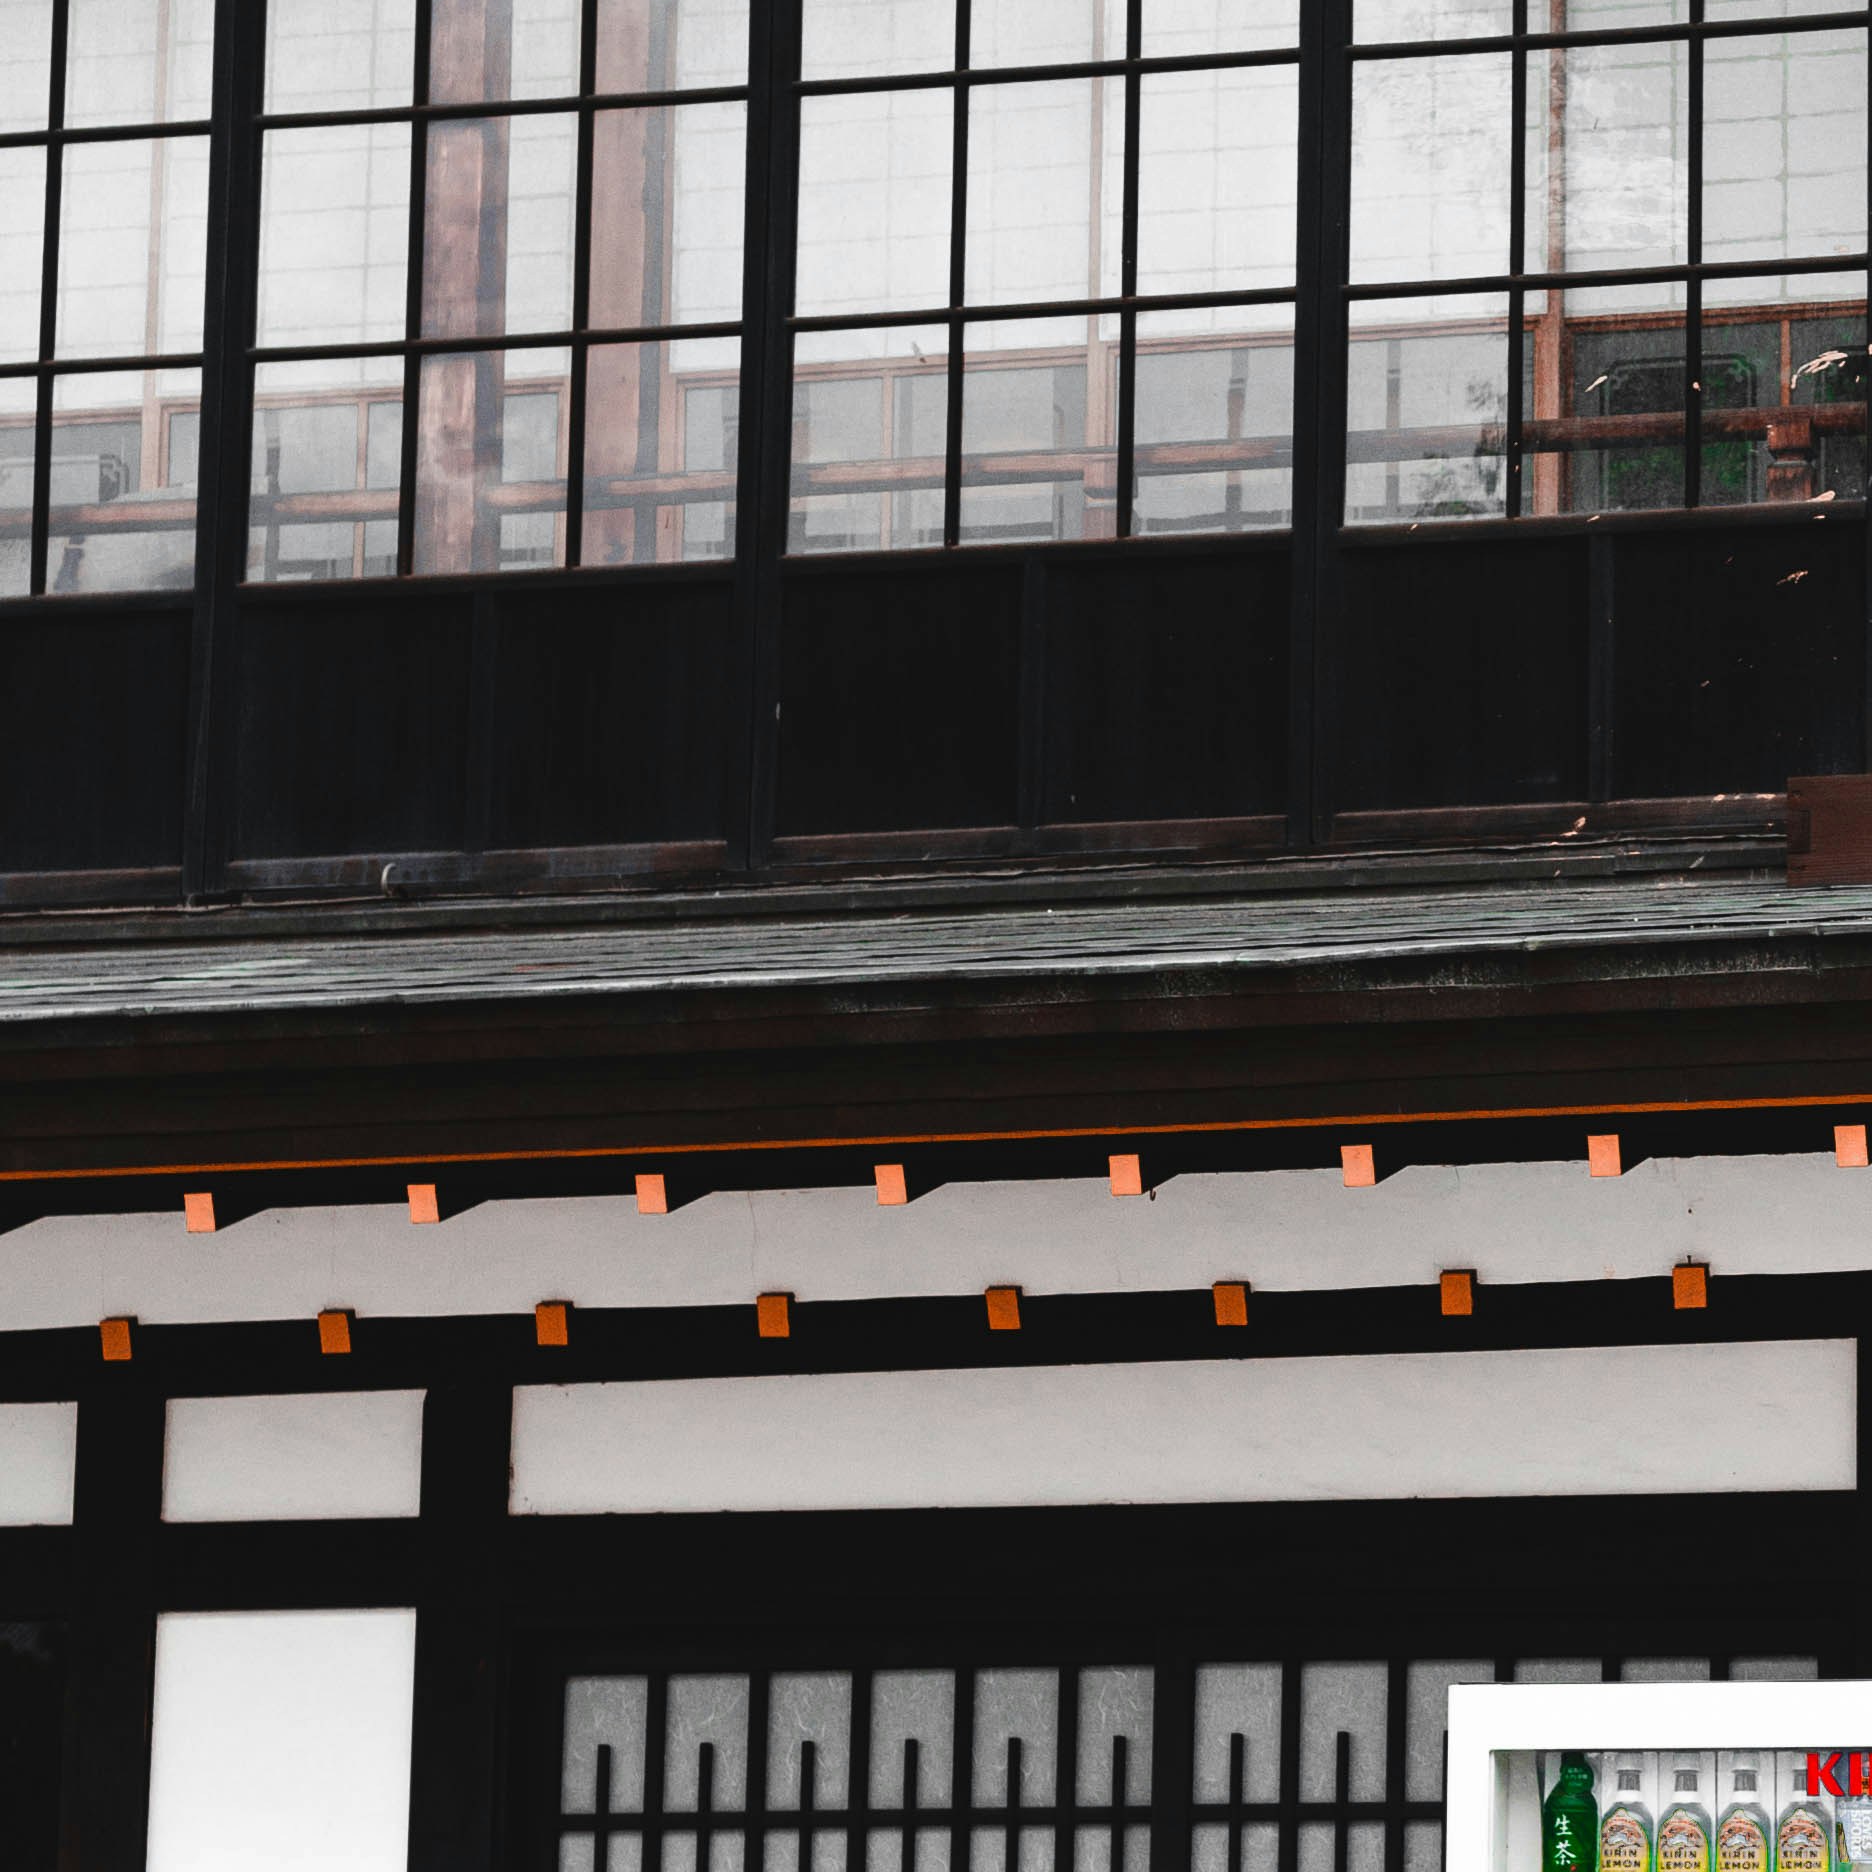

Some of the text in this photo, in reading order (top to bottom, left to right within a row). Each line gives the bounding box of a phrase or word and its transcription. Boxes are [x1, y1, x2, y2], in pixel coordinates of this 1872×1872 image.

[1851, 1809, 1861, 1859] SPORTS
[1554, 1814, 1577, 1866] 生茶
[1604, 1849, 1637, 1857] KIRIN
[1663, 1850, 1697, 1859] KIRIN
[1722, 1850, 1755, 1859] KIRIN
[1783, 1850, 1818, 1859] KIRIN
[1602, 1860, 1641, 1869] LEMON
[1660, 1860, 1700, 1869] LEMON
[1720, 1860, 1759, 1870] LEMON
[1781, 1861, 1821, 1870] LEMON
